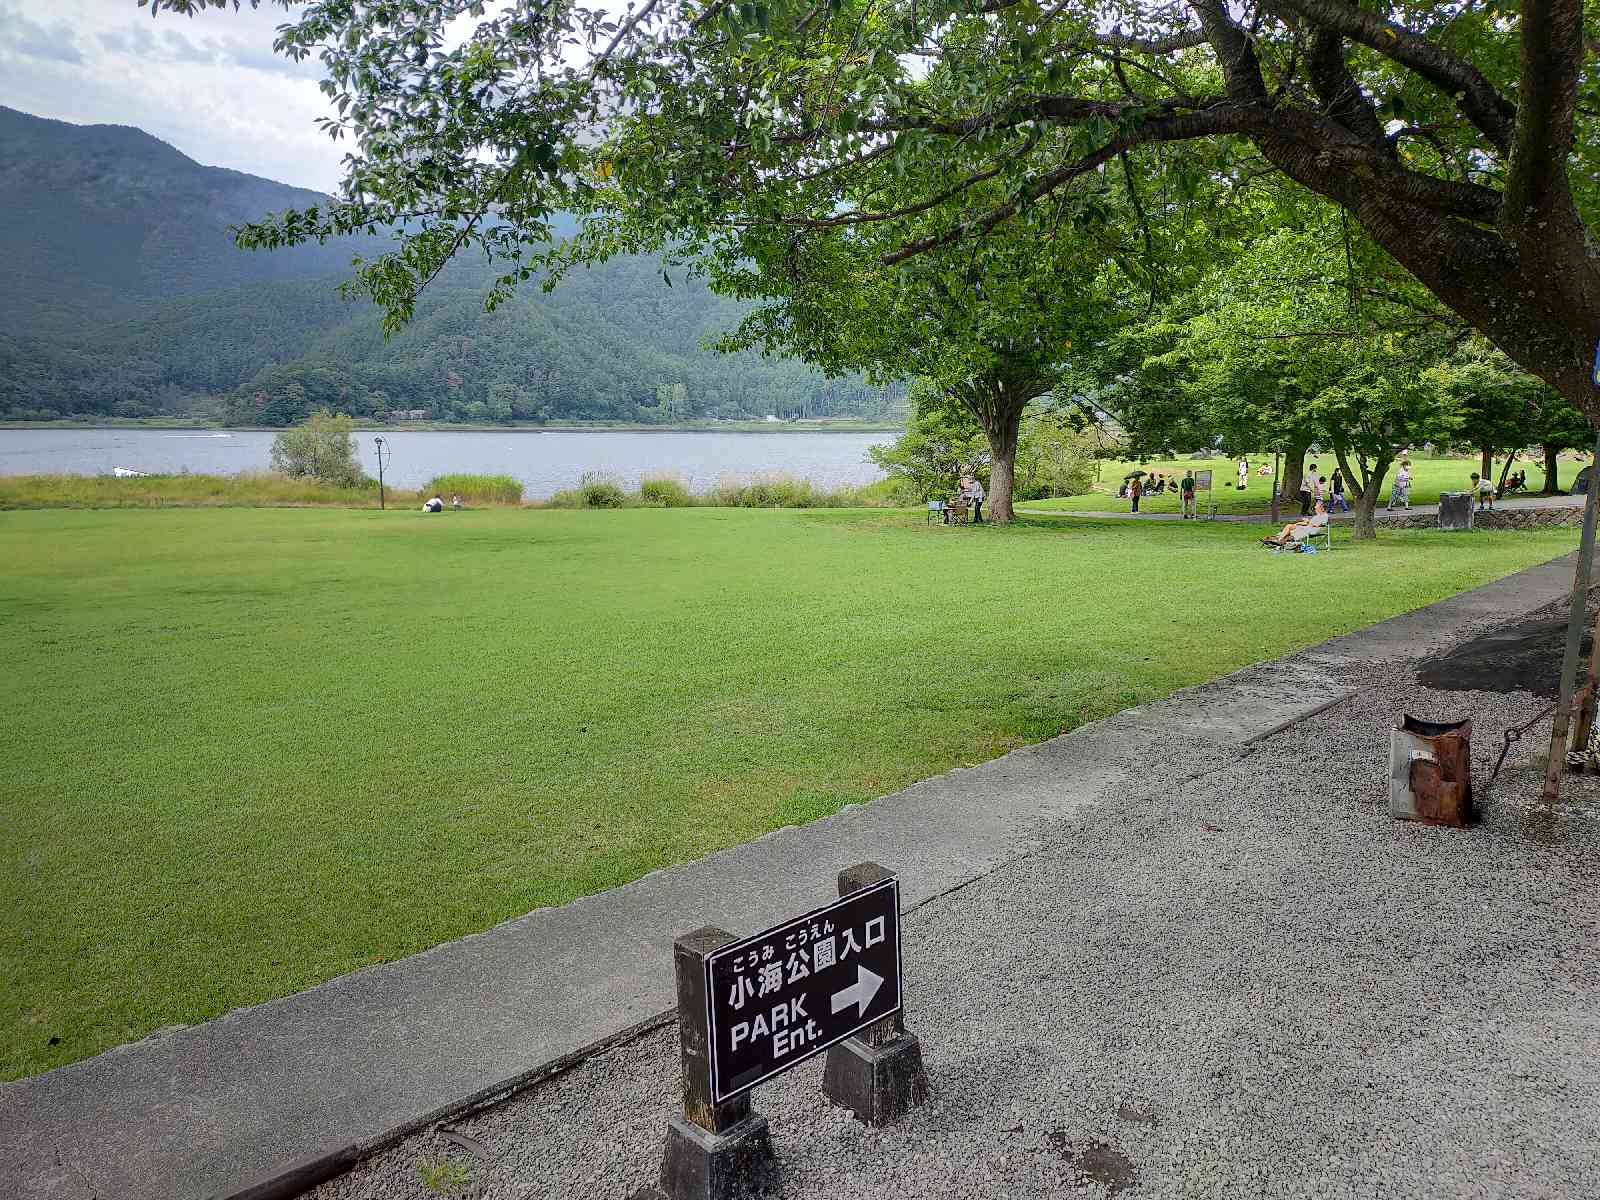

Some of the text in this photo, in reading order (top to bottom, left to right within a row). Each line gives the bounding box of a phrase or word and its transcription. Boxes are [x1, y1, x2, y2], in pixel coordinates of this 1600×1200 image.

[728, 915, 885, 1010] 小海公園入口
[733, 919, 835, 973] こうみ こうえん
[731, 993, 808, 1052] PARK
[773, 1019, 823, 1058] Ent.
